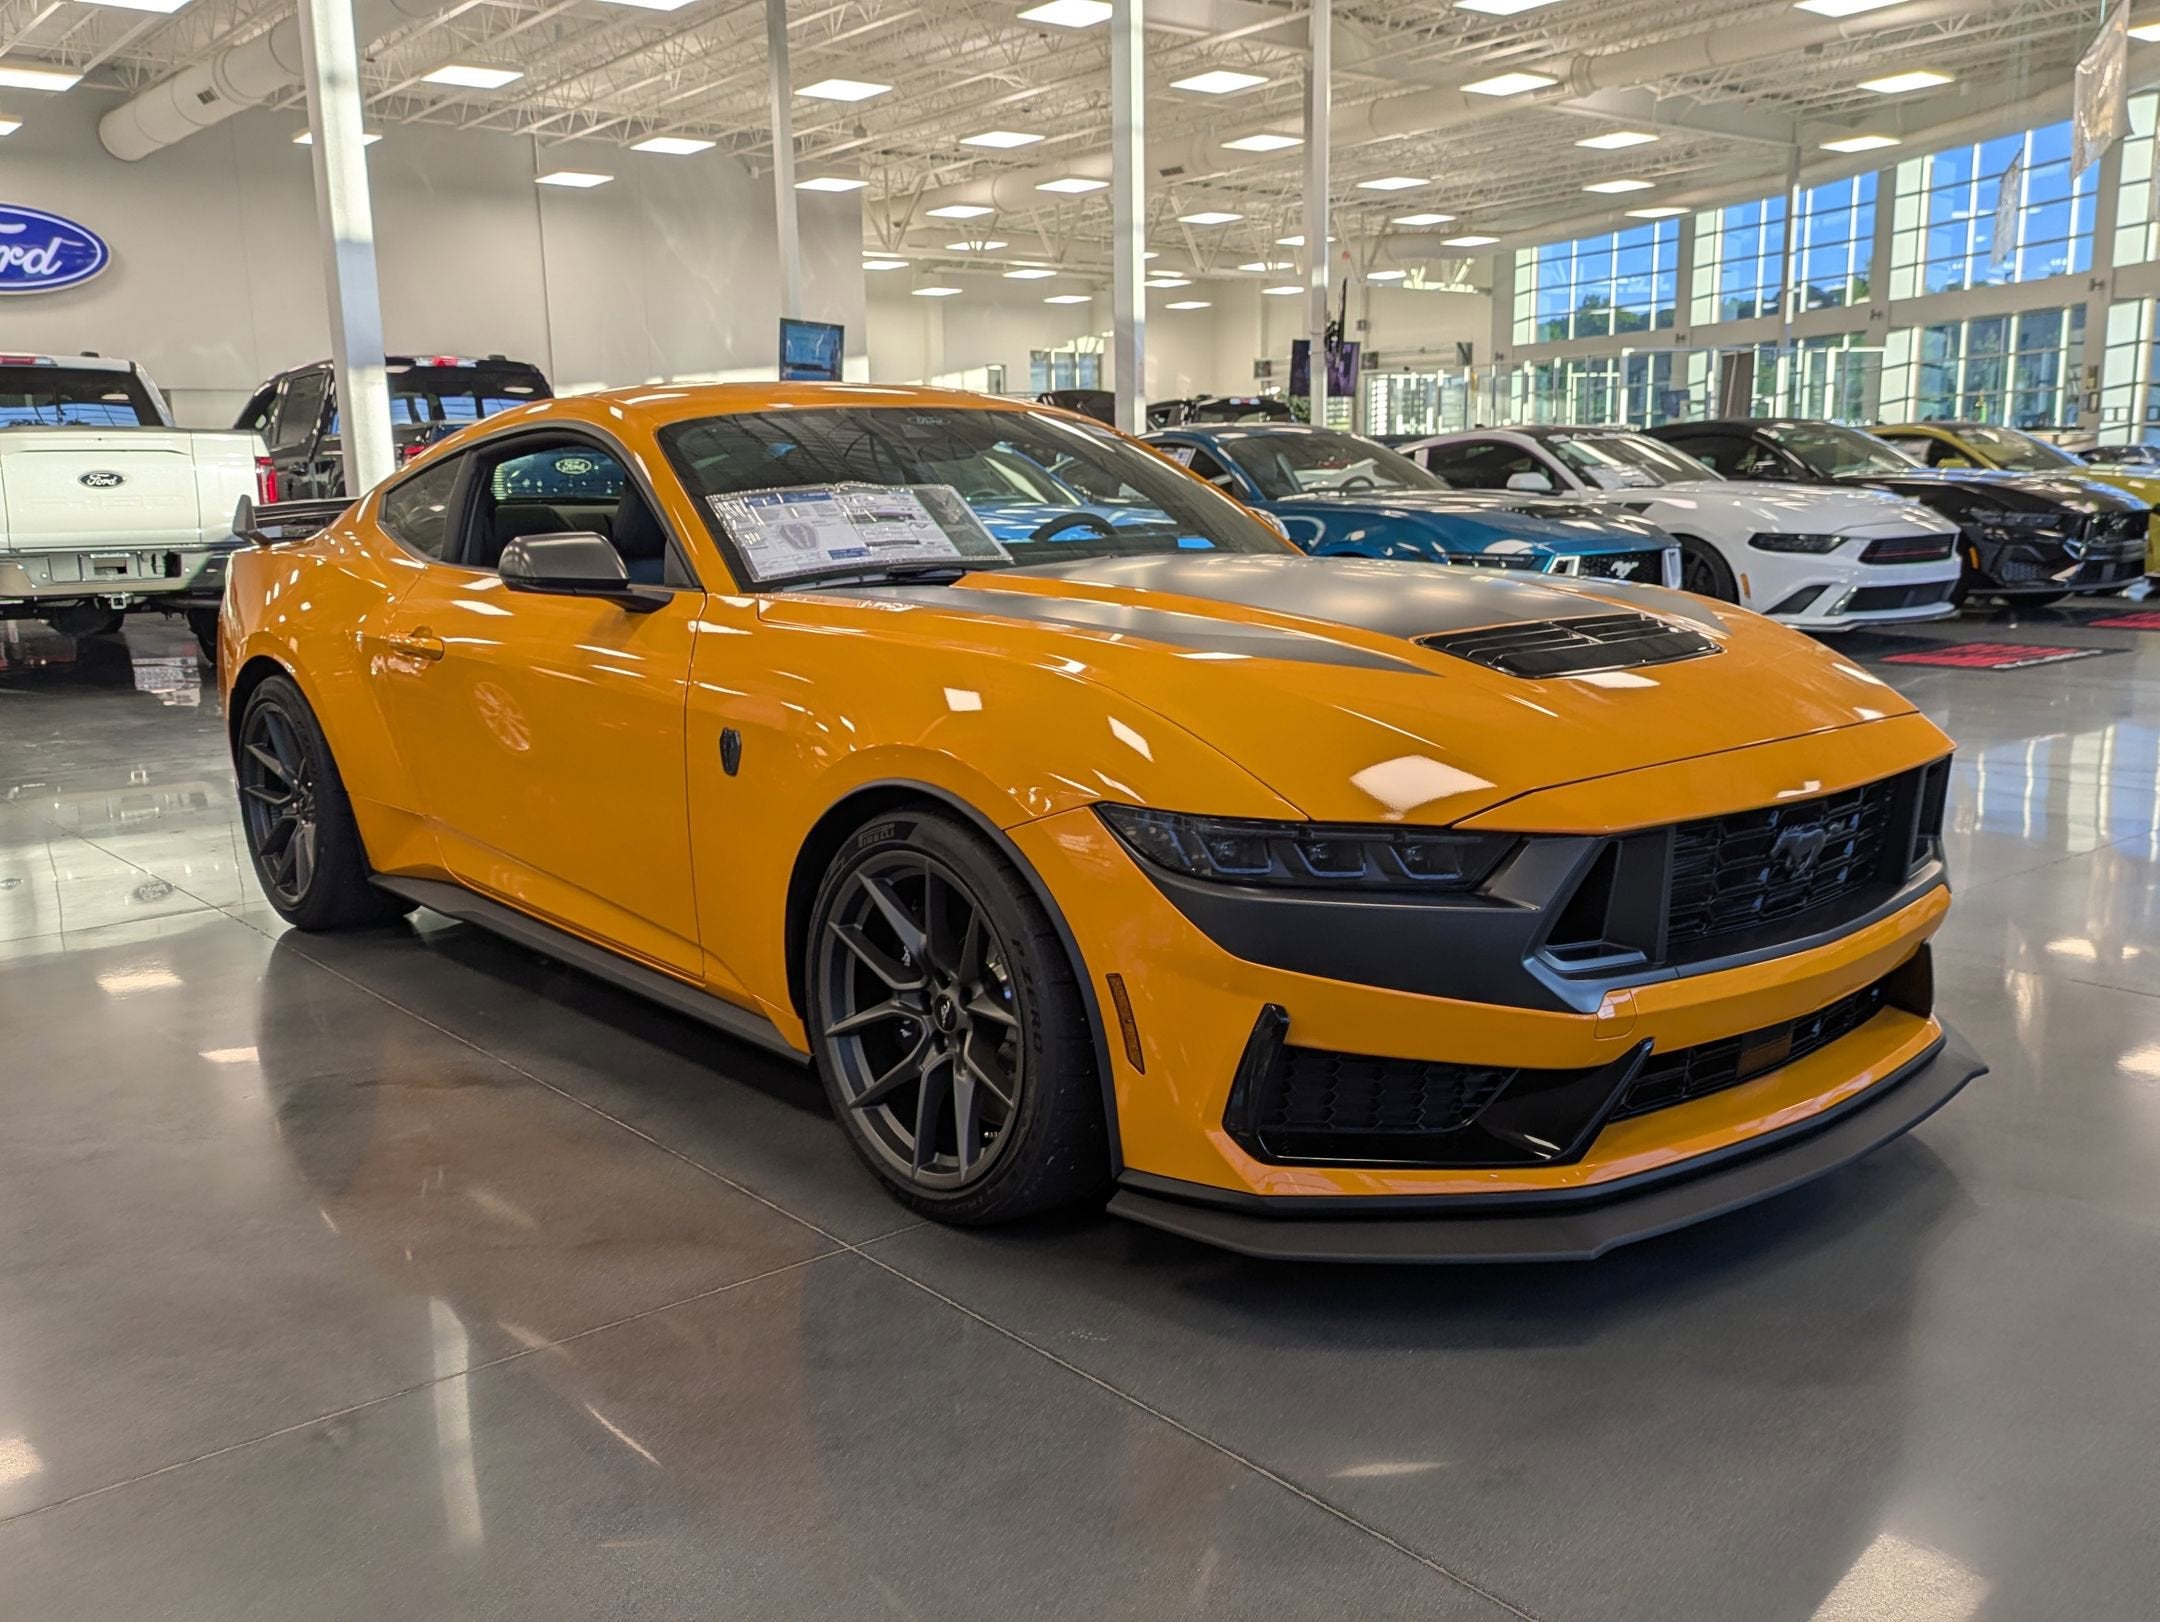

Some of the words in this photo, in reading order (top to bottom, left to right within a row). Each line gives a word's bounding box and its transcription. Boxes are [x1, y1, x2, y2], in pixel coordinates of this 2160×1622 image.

[0, 223, 63, 275] rd
[86, 473, 119, 487] Ford
[858, 823, 896, 848] PIRELLI
